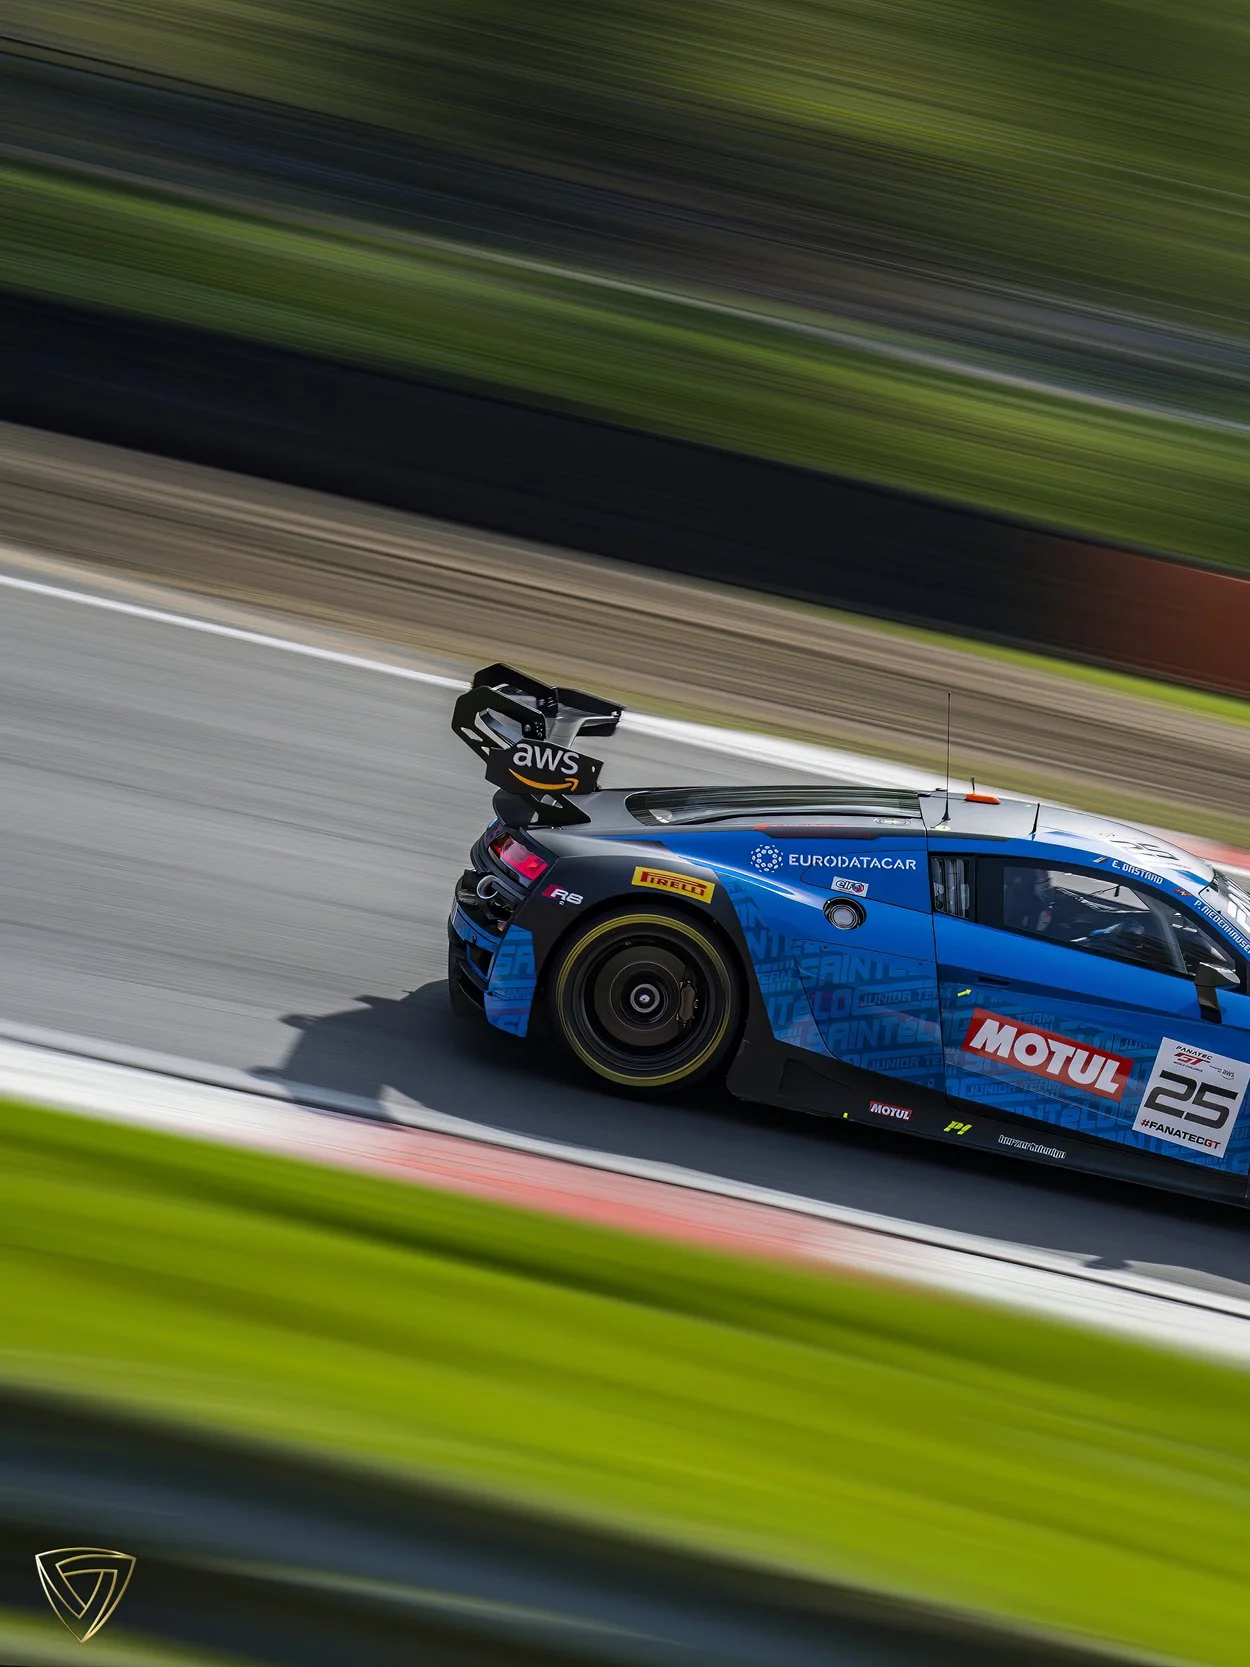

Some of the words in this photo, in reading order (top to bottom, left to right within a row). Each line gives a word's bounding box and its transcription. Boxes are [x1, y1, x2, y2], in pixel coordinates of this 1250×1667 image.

[512, 742, 580, 775] aws
[788, 854, 917, 870] EURODATACAR
[1122, 863, 1163, 885] BASTARD
[640, 871, 707, 897] PIRELLI
[550, 888, 584, 905] R8
[969, 1019, 1120, 1094] MOTUL
[1176, 1046, 1213, 1060] FANATEC
[870, 1103, 910, 1120] MOTUL
[1144, 1070, 1238, 1129] 25
[1141, 1119, 1221, 1150] #FANATECGT
